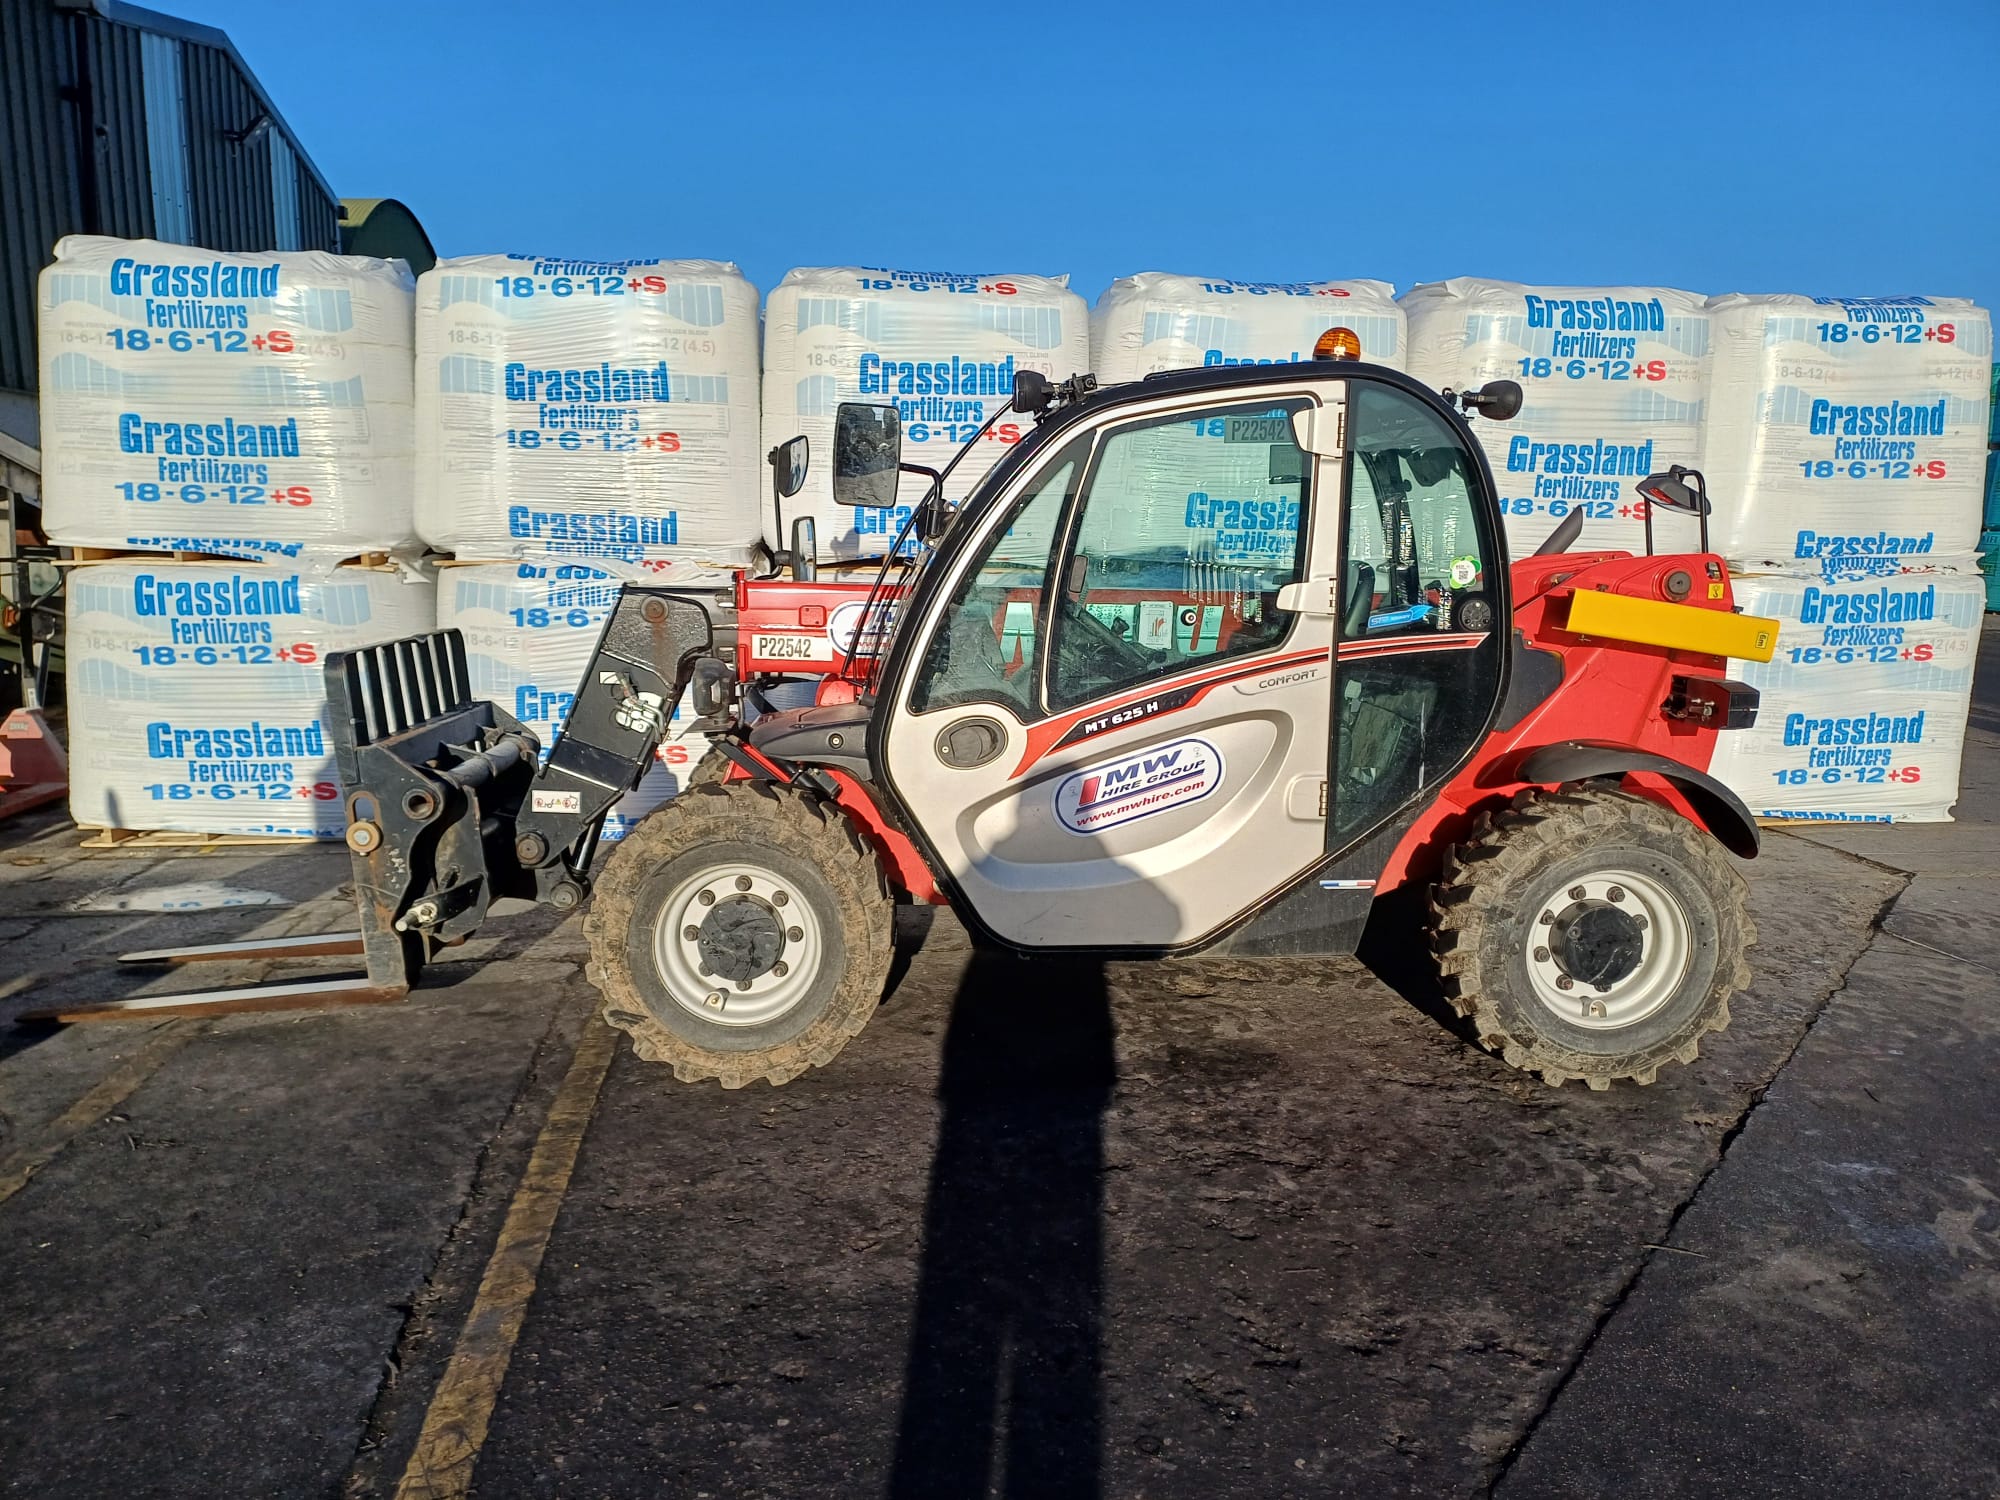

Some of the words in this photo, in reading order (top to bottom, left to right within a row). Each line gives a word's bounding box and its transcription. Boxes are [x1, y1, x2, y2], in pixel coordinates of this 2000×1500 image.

[111, 259, 280, 297] Grassland
[146, 298, 248, 329] Fertilizers
[1525, 295, 1664, 332] Grassland
[1552, 330, 1636, 358] Fertilizers
[504, 361, 671, 403] Grassland
[859, 353, 1015, 396] Grassland
[539, 403, 641, 431] Fertilizers
[1231, 420, 1286, 441] P22542
[1809, 399, 1946, 436] Grassland
[119, 413, 300, 458] Grassland
[1834, 438, 1915, 460] Fertilizers
[158, 456, 268, 485] Fertilizers
[1506, 436, 1653, 477] Grassland
[1534, 475, 1620, 501] Fertilizers
[508, 506, 678, 546] Grassland
[1795, 530, 1934, 558] Grassland
[134, 575, 301, 616] Grassland
[1800, 585, 1935, 624] Grassland
[171, 618, 273, 646] Fertilizers
[759, 637, 811, 658] P22542
[1822, 625, 1904, 647] Fertilizers
[1259, 669, 1318, 689] COMFORT
[1085, 718, 1108, 734] MT
[1112, 708, 1143, 726] 625
[1146, 702, 1159, 714] H
[1783, 711, 1925, 746] Grassland
[147, 720, 325, 758] Grassland
[188, 761, 294, 784] Fertilizers
[1808, 747, 1891, 768] Fertilizers
[1101, 779, 1142, 799] HIRE
[1147, 760, 1206, 784] GROUP
[1076, 780, 1205, 827] www.mwhire.com
